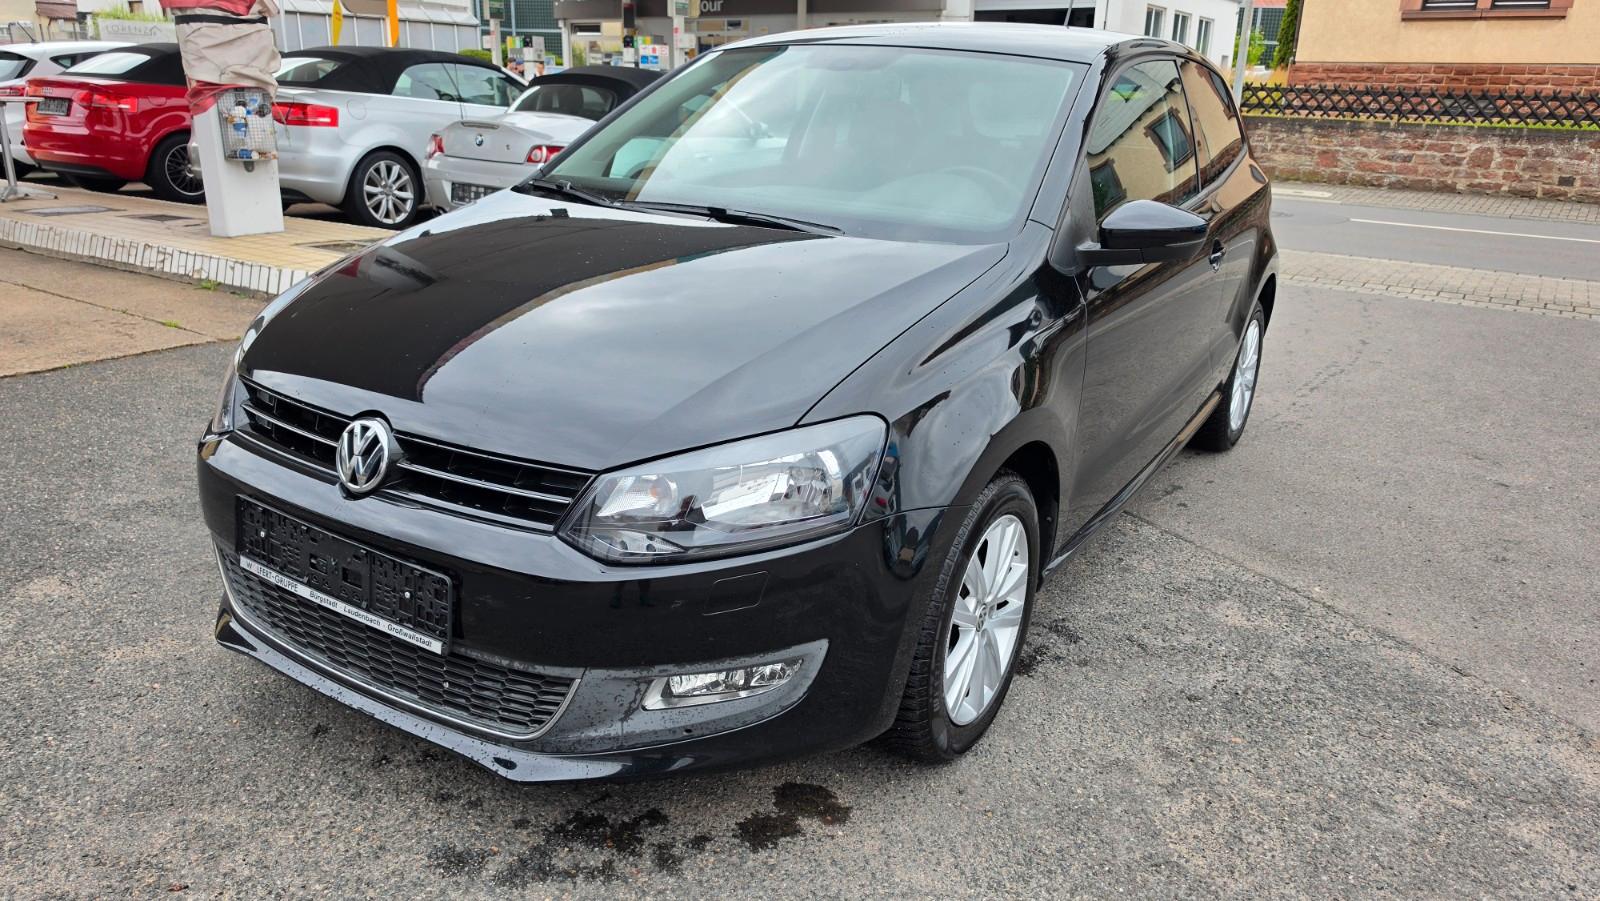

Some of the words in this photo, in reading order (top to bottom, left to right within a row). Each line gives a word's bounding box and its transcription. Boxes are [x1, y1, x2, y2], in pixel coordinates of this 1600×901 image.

[246, 561, 298, 592] WLFERT-GRUPPE
[309, 590, 338, 609] Bürgstadt
[343, 605, 381, 627] Laudenbach
